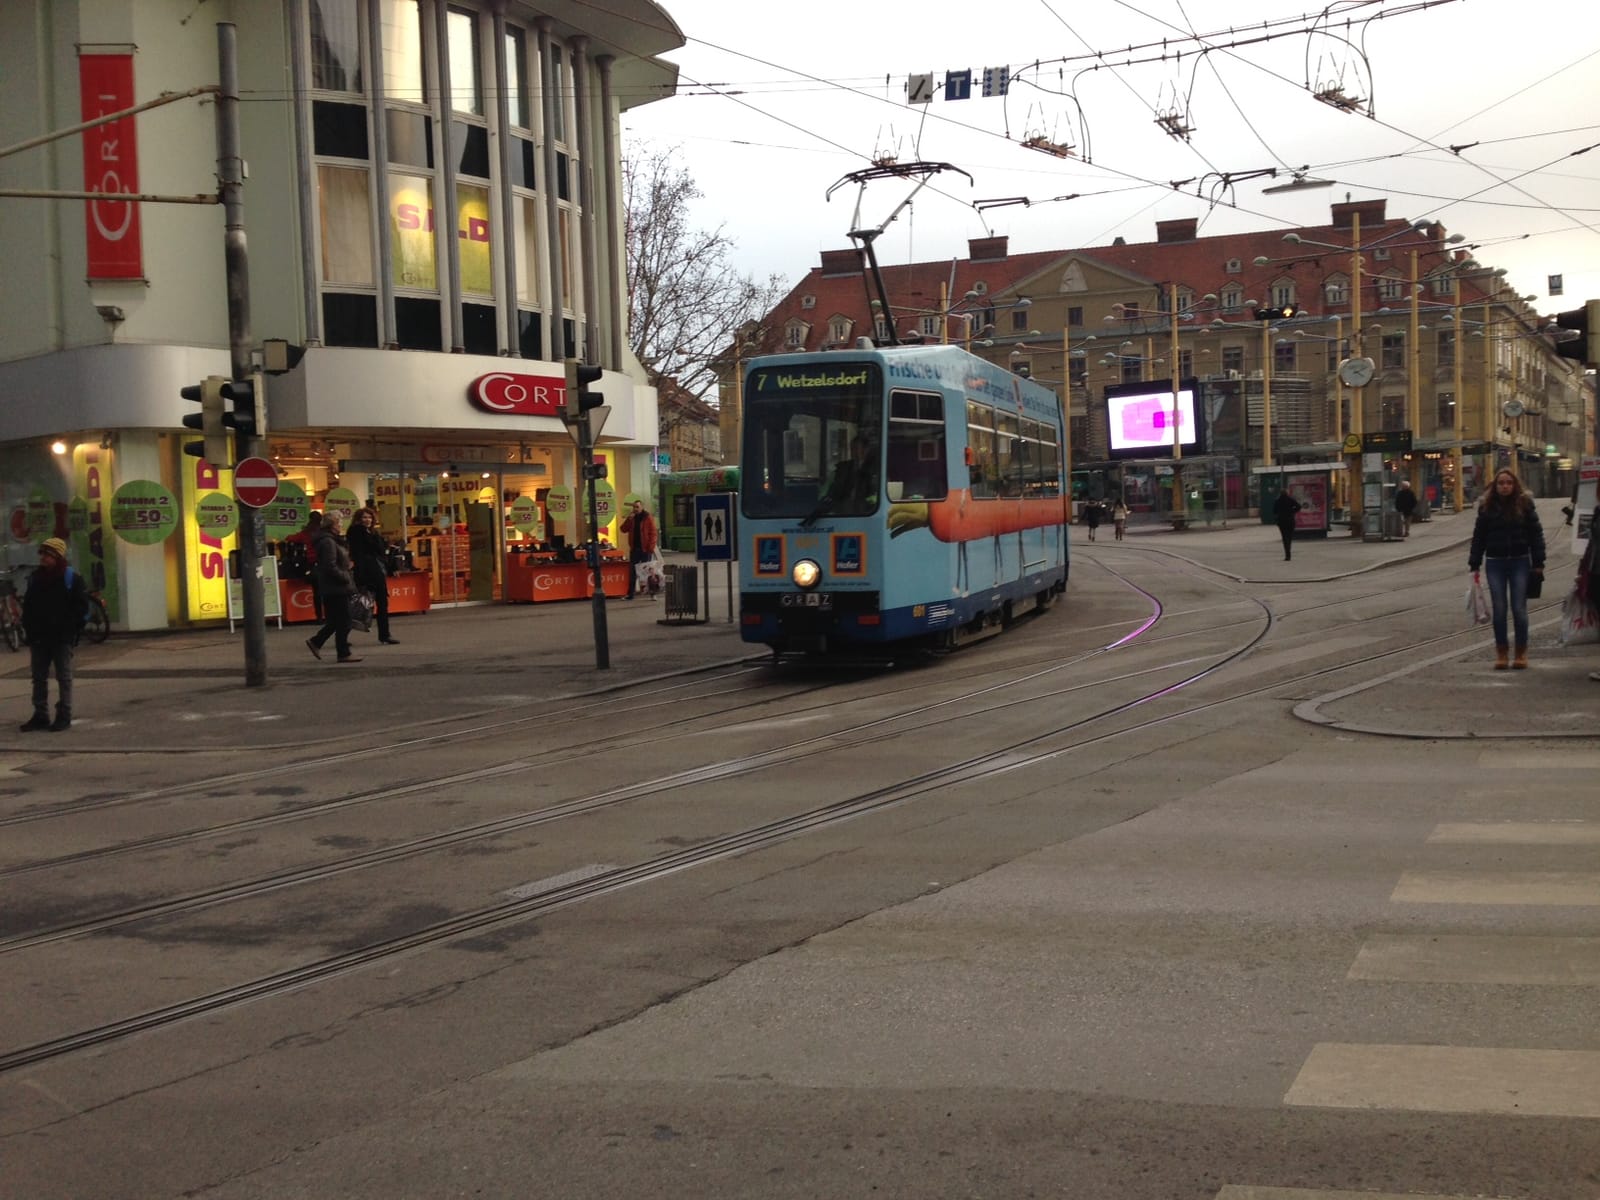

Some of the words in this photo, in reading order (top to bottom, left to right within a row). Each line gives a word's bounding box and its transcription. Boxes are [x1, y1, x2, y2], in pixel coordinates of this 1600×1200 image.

[757, 374, 768, 391] 7
[777, 370, 868, 388] Wetzelsdorf
[478, 373, 567, 410] CORT
[442, 480, 479, 493] SALDI
[534, 574, 575, 591] CORTI
